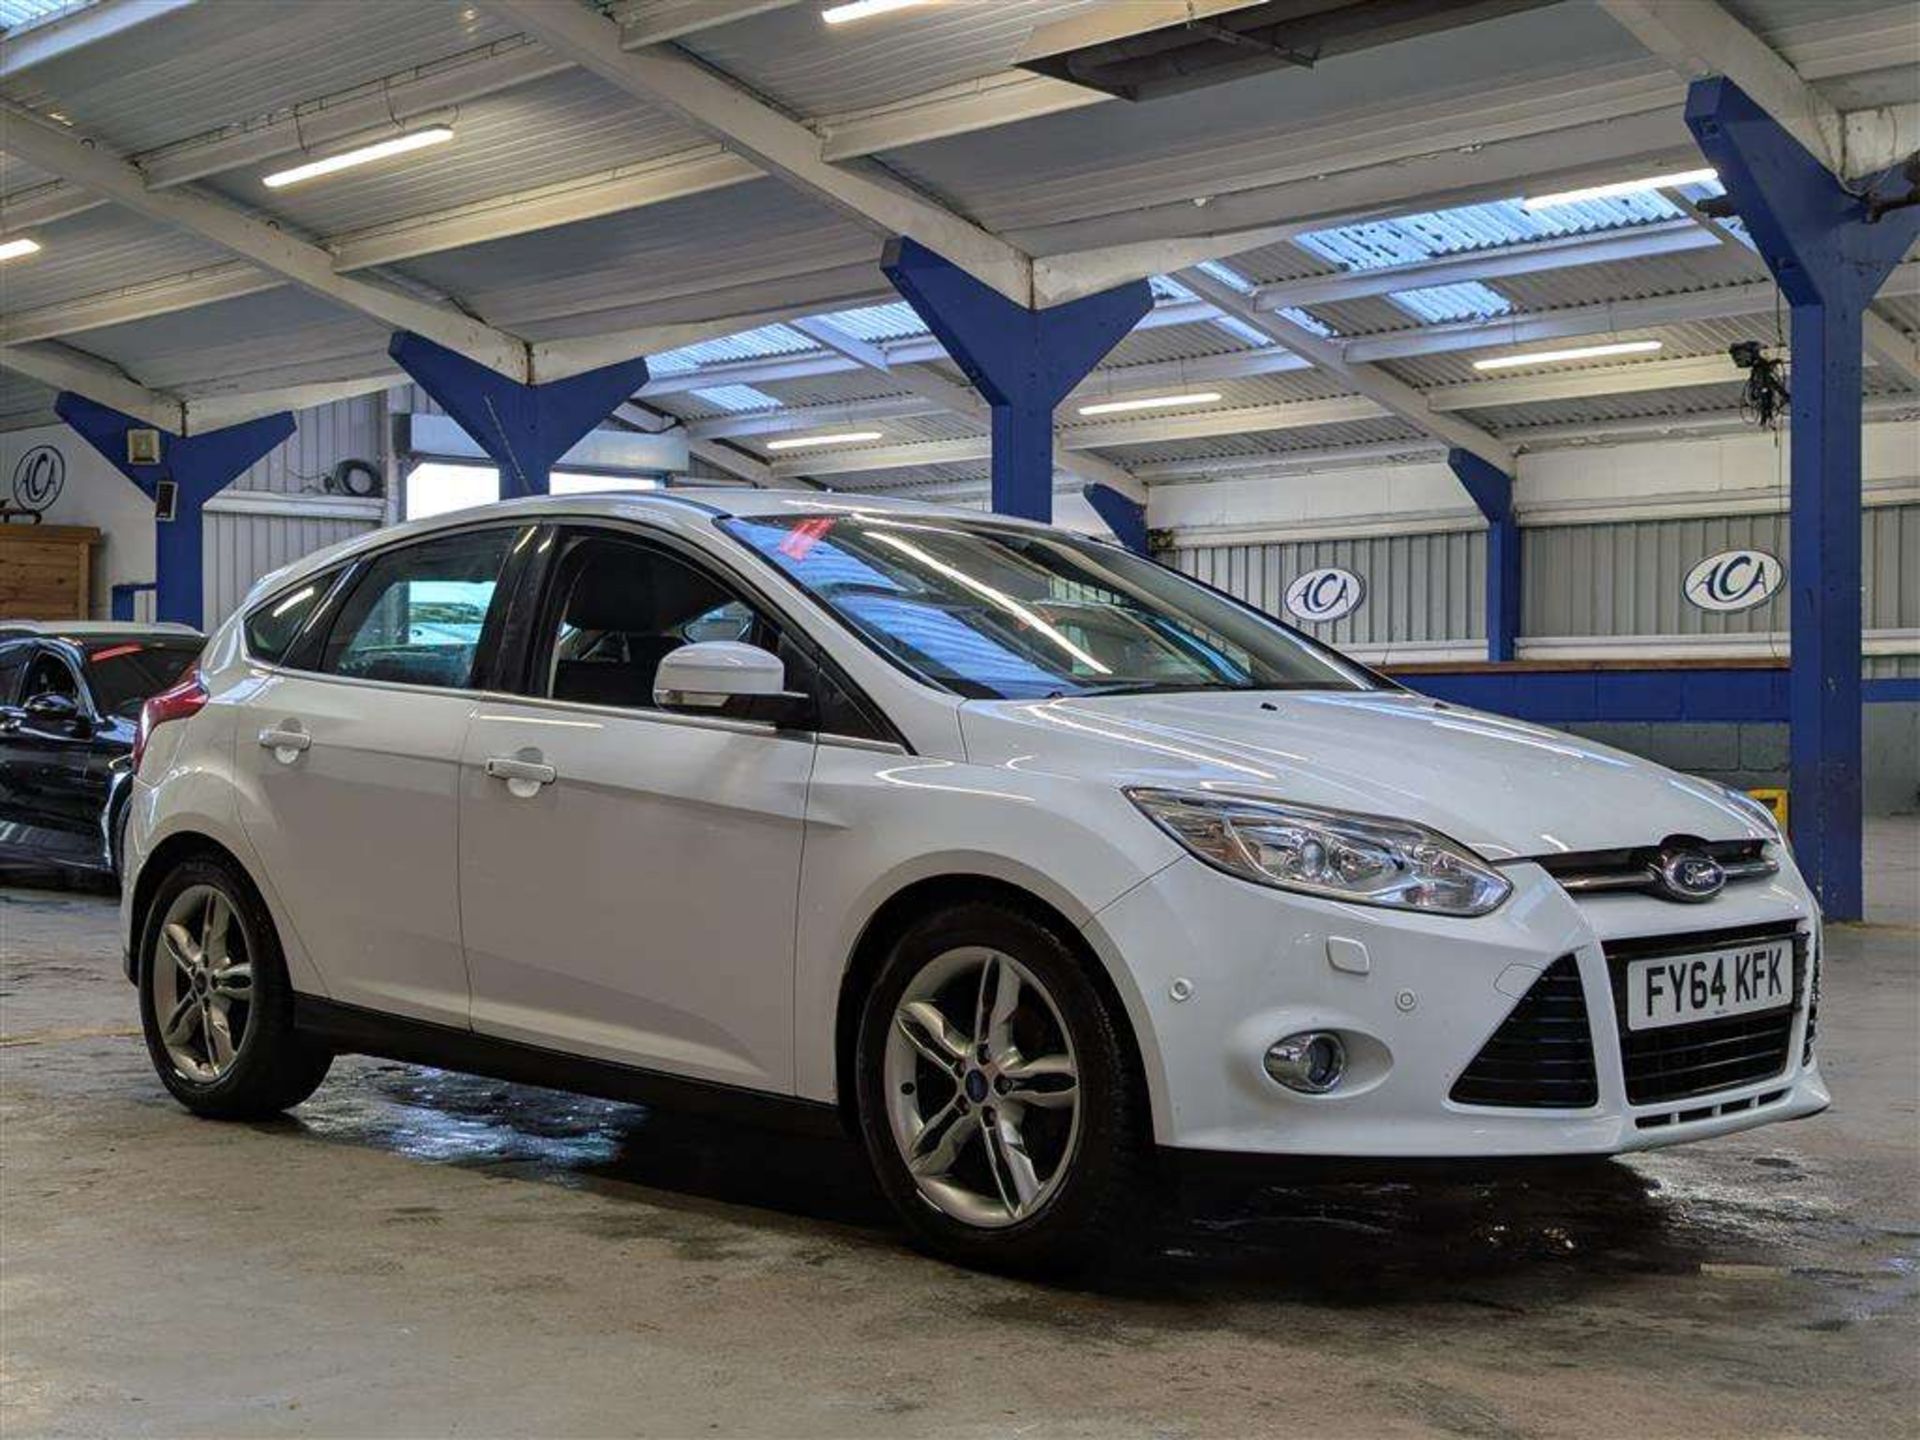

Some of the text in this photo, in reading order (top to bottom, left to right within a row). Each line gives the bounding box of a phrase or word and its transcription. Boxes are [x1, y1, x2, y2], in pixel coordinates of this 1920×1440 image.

[20, 452, 57, 503] ACA
[1293, 573, 1349, 614] ACA
[1690, 556, 1767, 603] ACA
[1684, 862, 1716, 885] Ford
[1645, 947, 1783, 1017] FY64 KFK
